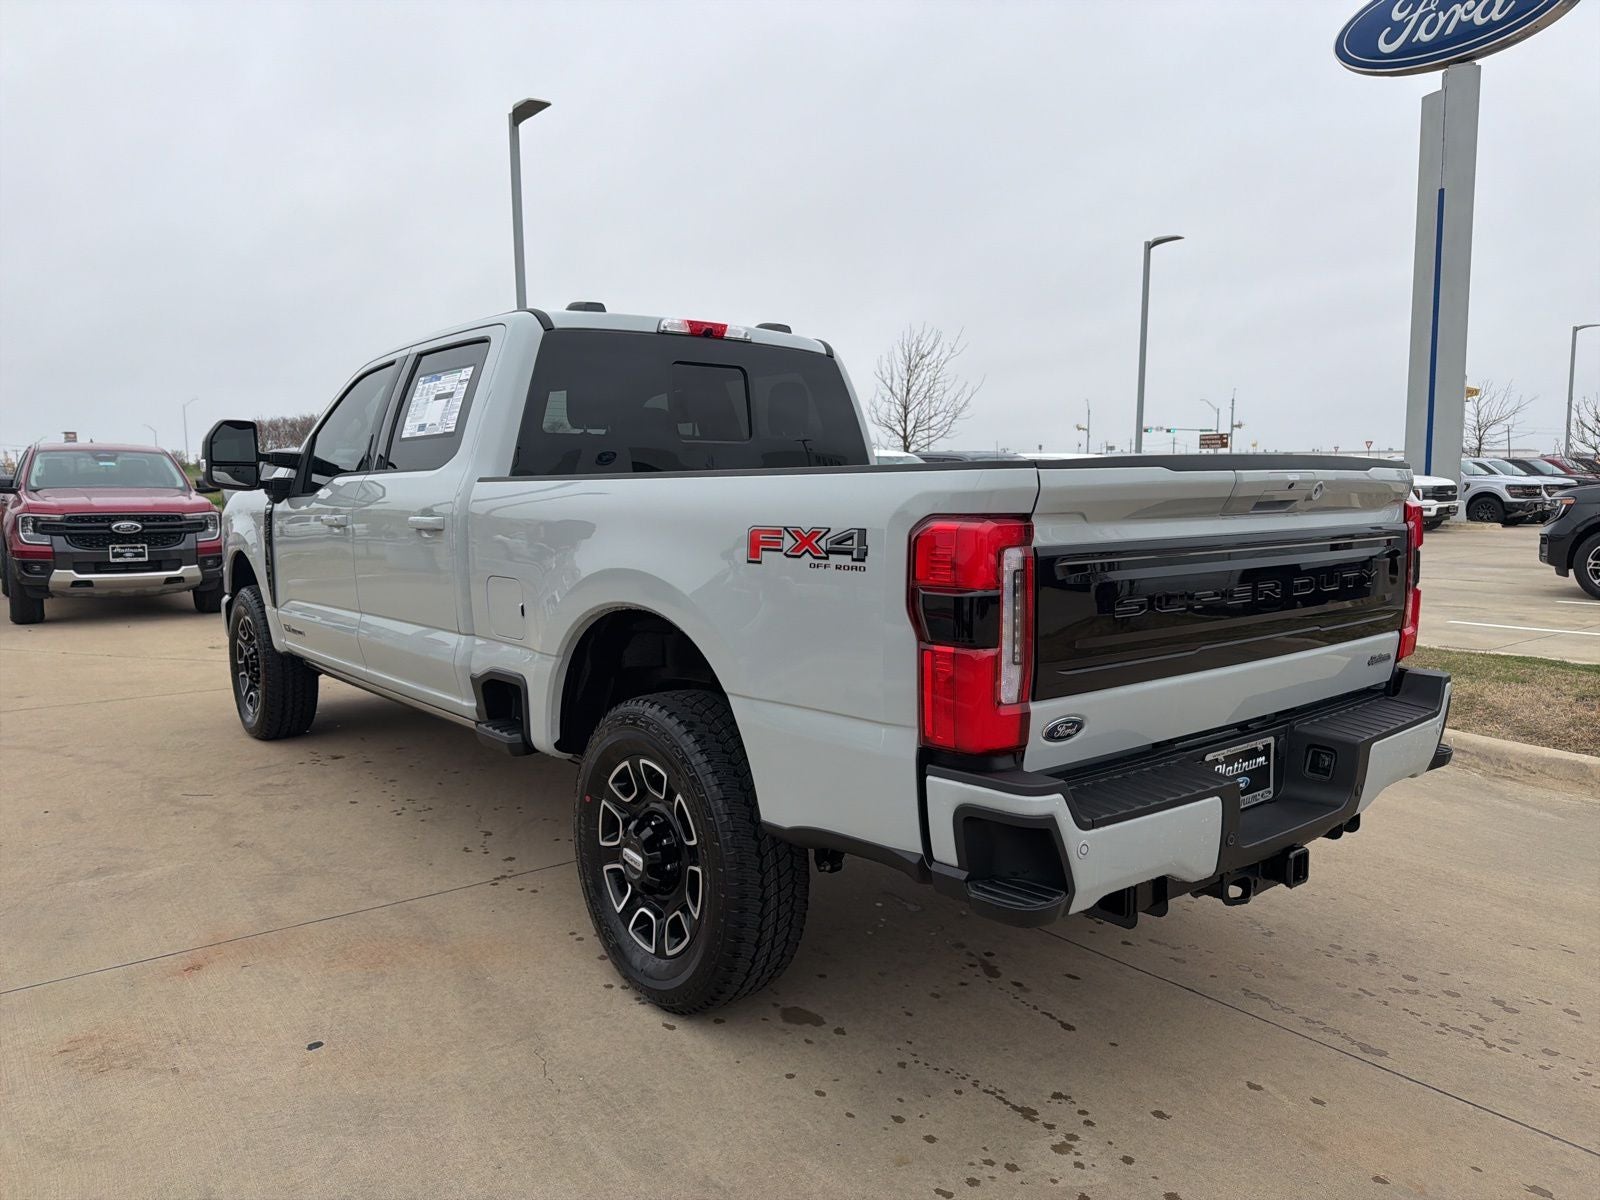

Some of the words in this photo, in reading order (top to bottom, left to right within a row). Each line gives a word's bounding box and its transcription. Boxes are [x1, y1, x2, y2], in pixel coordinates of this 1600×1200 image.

[1377, 0, 1516, 54] Ford
[747, 525, 868, 564] FX4
[809, 562, 831, 570] OFF
[835, 564, 866, 572] ROAD
[1114, 579, 1282, 618] SUPER
[1293, 568, 1378, 596] DUTY
[1214, 756, 1269, 777] Platinum
